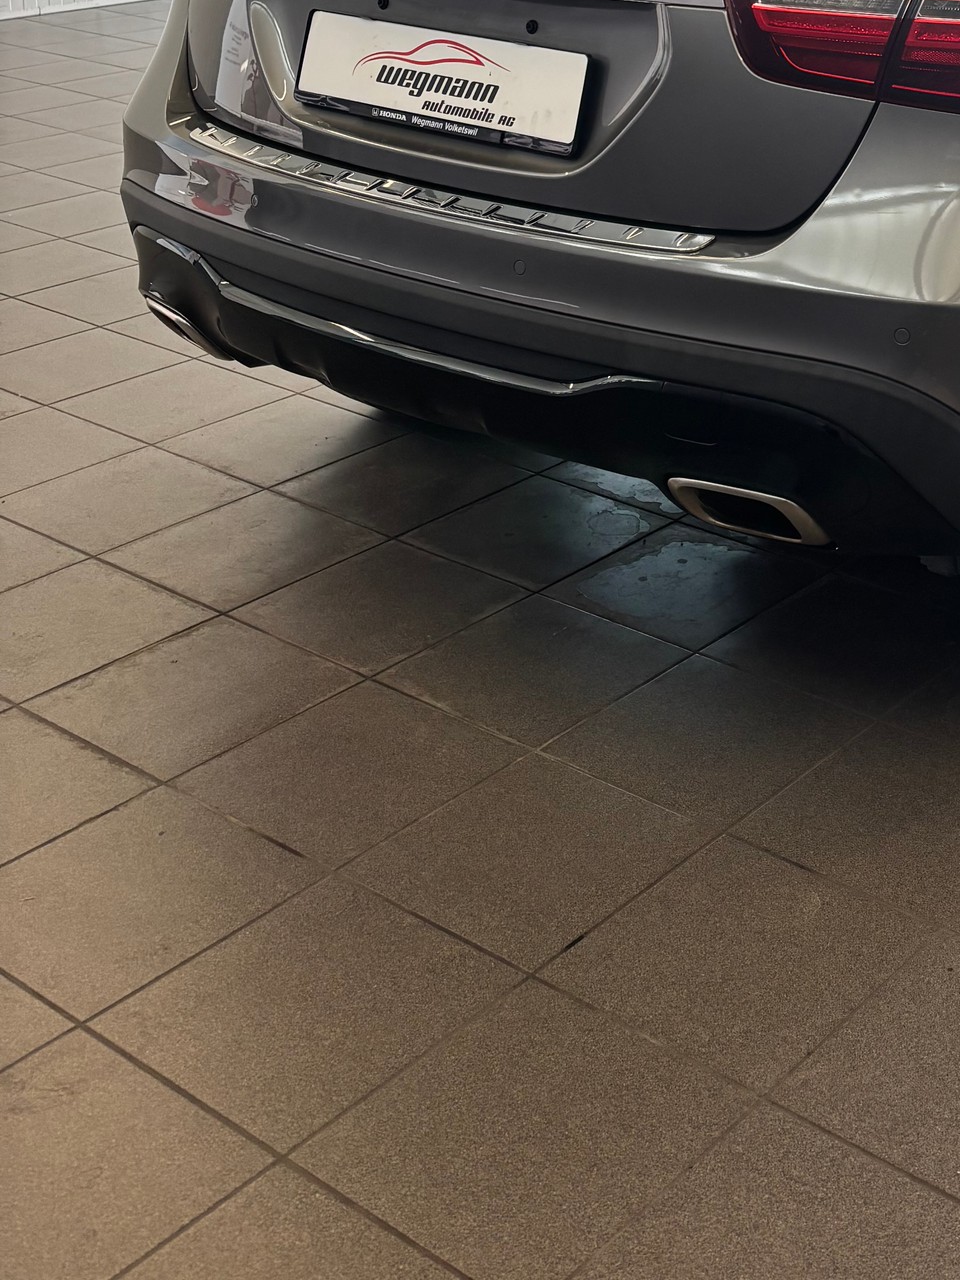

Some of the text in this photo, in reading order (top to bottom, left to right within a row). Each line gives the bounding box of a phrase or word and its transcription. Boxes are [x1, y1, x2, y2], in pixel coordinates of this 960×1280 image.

[376, 65, 500, 104] wegmann
[379, 110, 479, 137] HONDA Wegmann Volketswil
